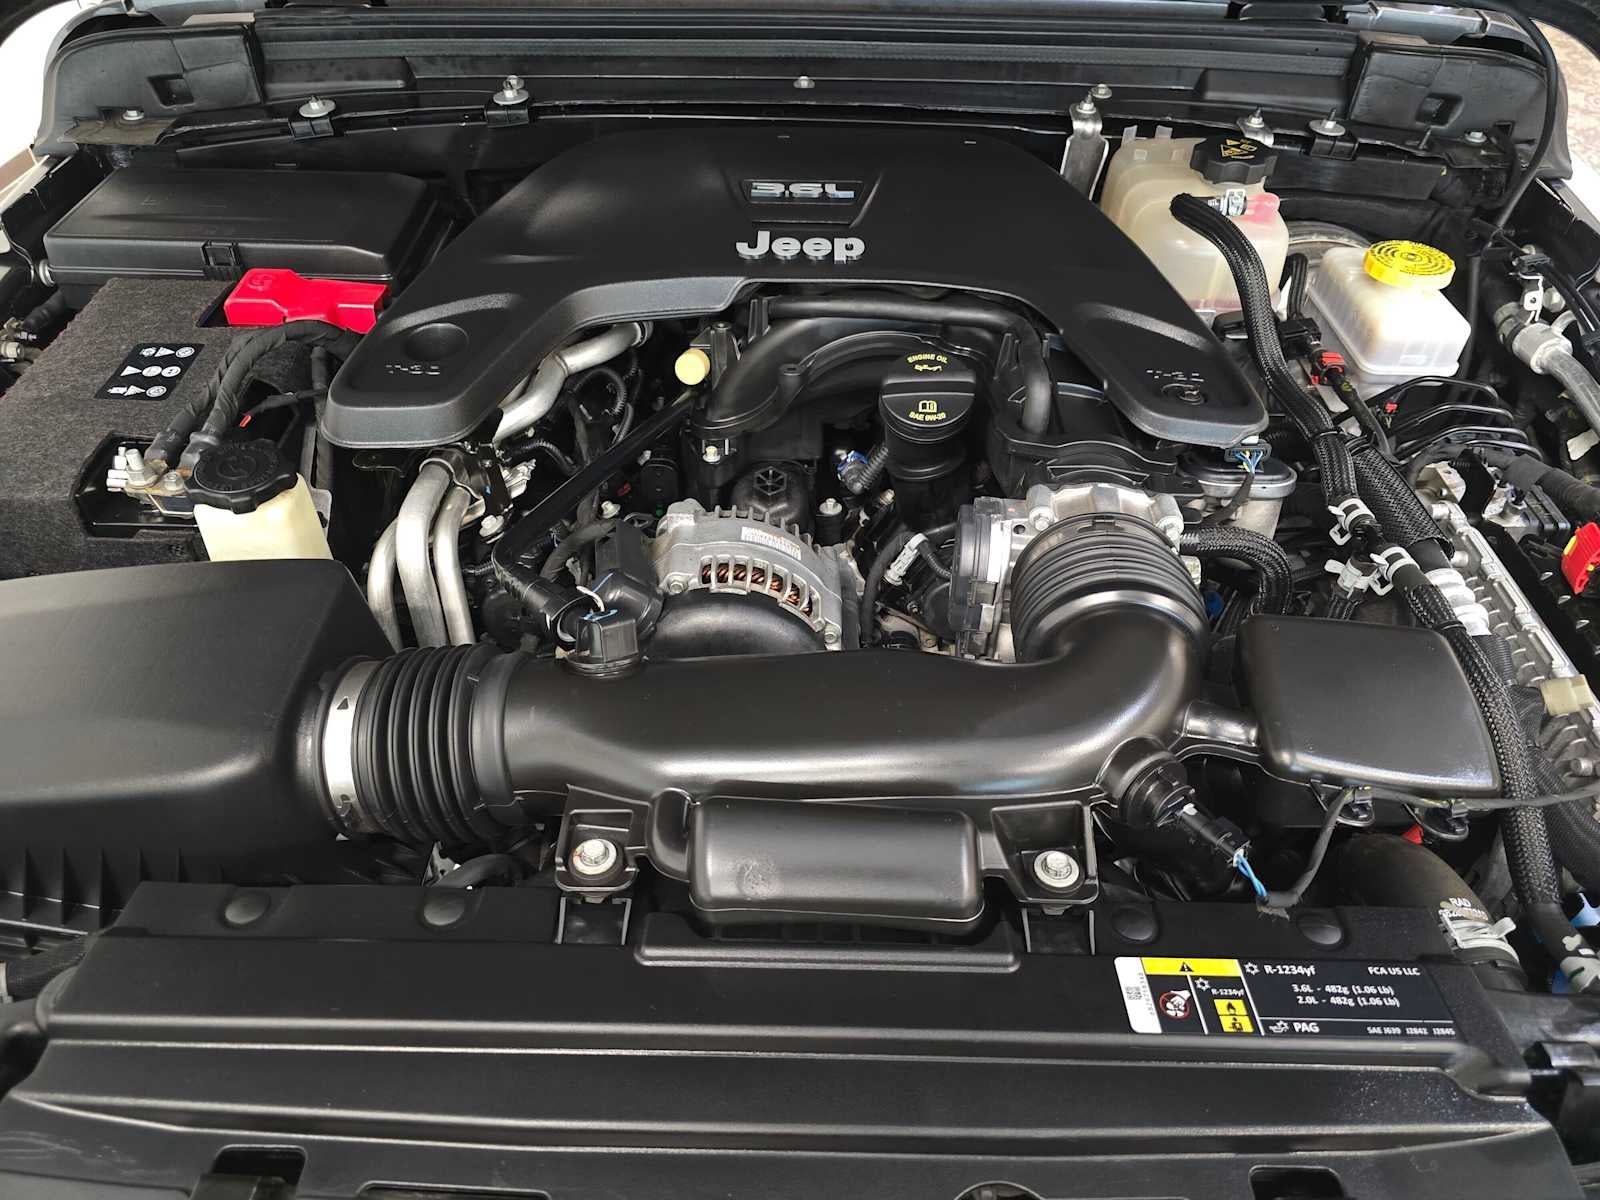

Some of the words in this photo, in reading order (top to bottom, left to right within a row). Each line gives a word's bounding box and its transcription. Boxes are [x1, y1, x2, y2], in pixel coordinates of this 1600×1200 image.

[751, 182, 855, 199] 3.6L
[735, 230, 866, 264] Jeep
[907, 354, 935, 363] ENGINE
[936, 355, 948, 363] OIL
[909, 411, 924, 420] SAE
[925, 412, 946, 421] 0W-20
[1449, 897, 1471, 907] RAD
[1263, 965, 1316, 976] R-1234yf
[1367, 966, 1387, 975] FCA
[1388, 967, 1402, 975] US
[1402, 967, 1421, 976] LLC
[1292, 984, 1313, 992] 3.6L
[1325, 985, 1349, 995] 482g
[1377, 986, 1395, 996] Lb)
[1297, 996, 1319, 1004] 2.0L
[1330, 997, 1355, 1007] 482g
[1382, 998, 1400, 1008] Lb)
[1293, 1022, 1320, 1033] PAG
[1367, 1026, 1382, 1034] SAE
